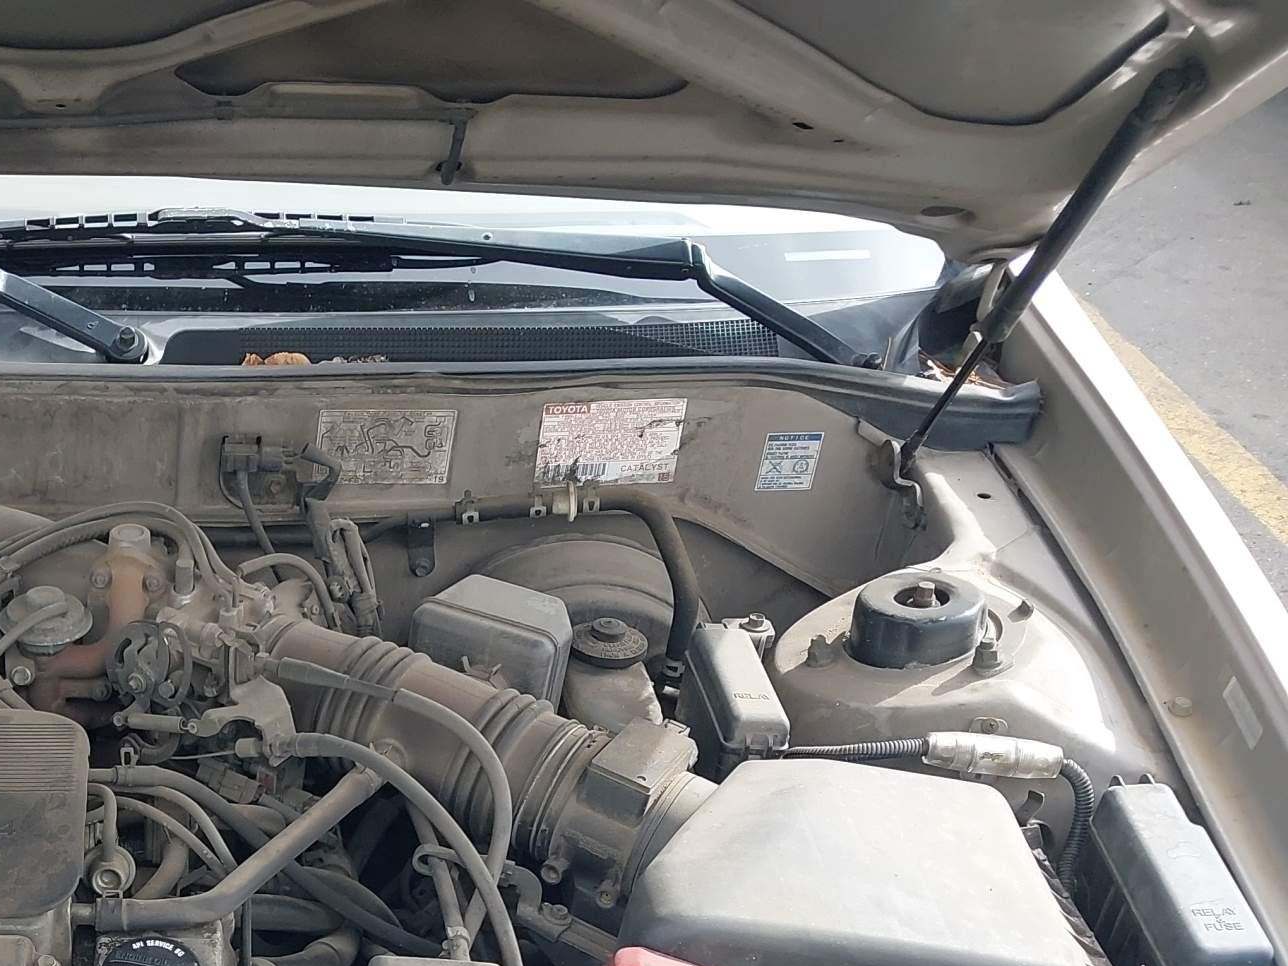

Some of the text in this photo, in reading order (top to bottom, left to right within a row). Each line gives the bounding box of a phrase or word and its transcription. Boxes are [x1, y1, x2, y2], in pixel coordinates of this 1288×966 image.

[548, 405, 588, 414] TOYOTA
[620, 463, 669, 472] CATALYST
[1191, 907, 1237, 917] RELAY
[1203, 922, 1245, 932] FUSE
[146, 940, 174, 951] SERVICE
